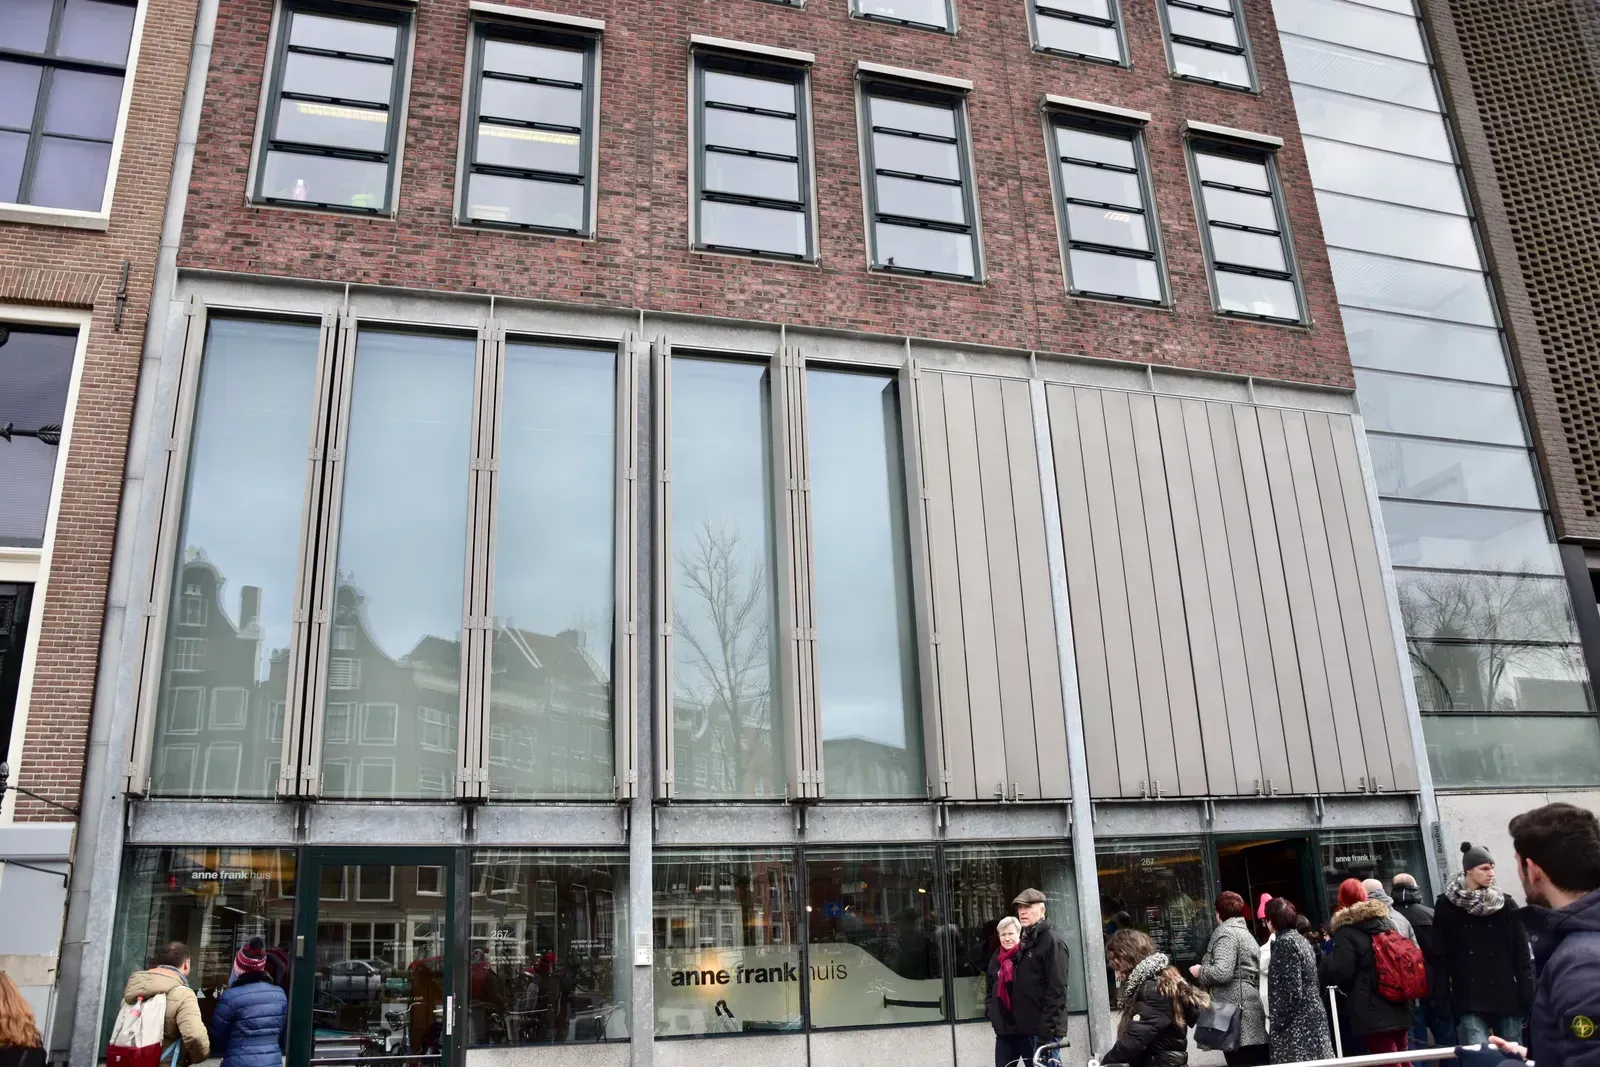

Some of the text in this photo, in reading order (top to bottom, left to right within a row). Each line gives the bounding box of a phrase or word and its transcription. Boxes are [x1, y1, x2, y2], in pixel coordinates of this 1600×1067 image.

[1434, 825, 1443, 854] ingang
[1140, 857, 1155, 866] 267
[1352, 854, 1369, 862] frank
[191, 869, 271, 880] anne frank huis
[490, 930, 509, 939] 267
[670, 969, 730, 987] anne
[736, 962, 798, 984] frank
